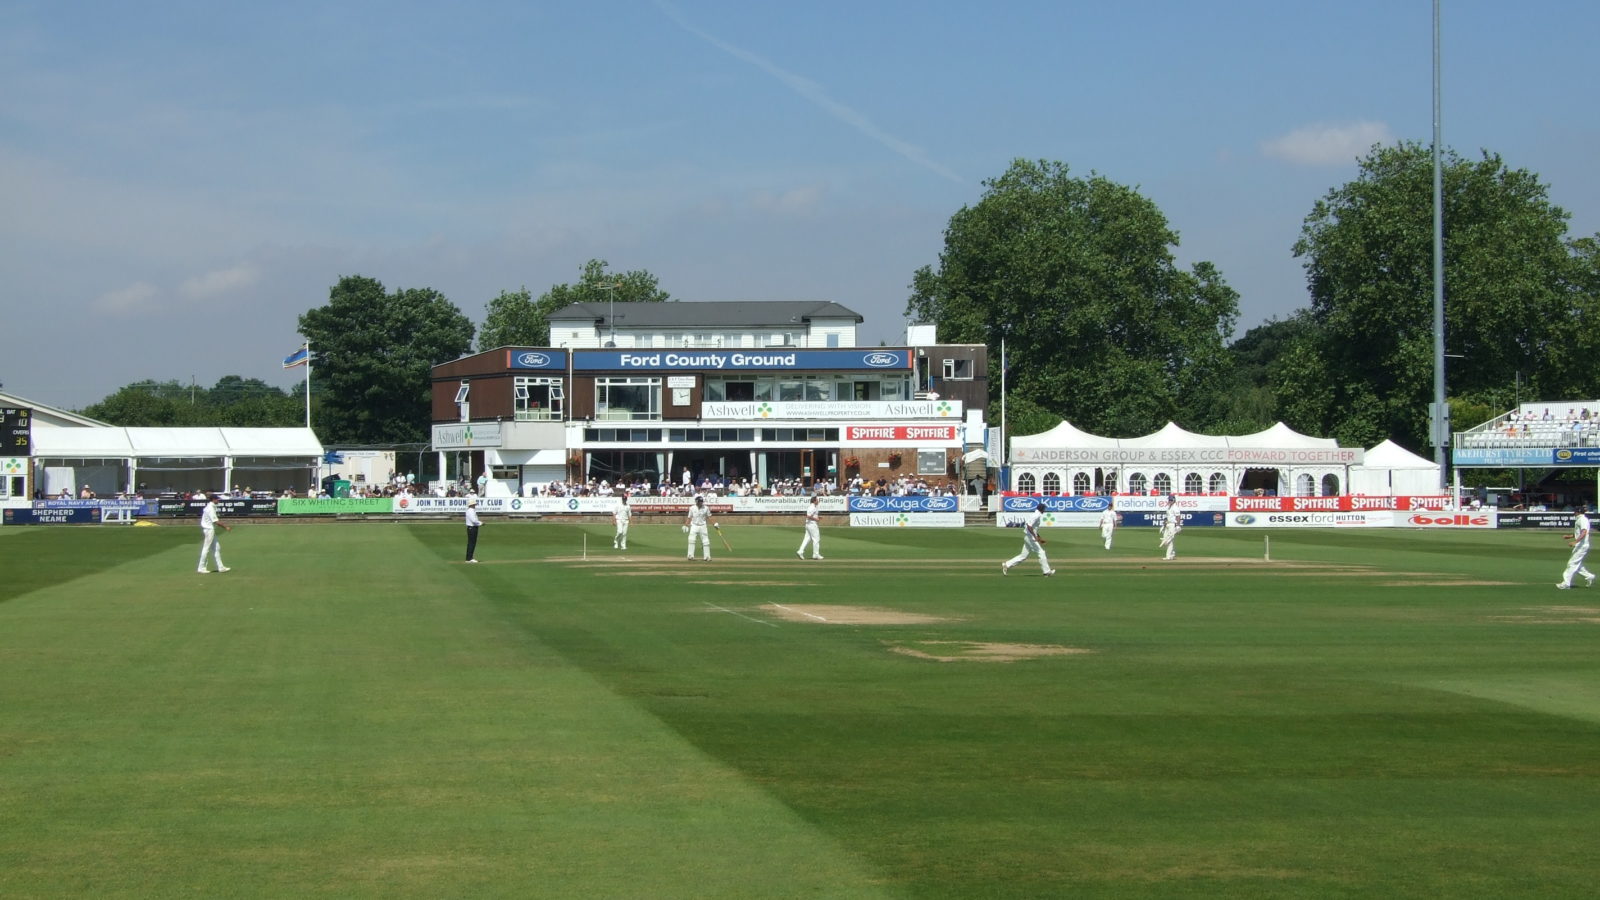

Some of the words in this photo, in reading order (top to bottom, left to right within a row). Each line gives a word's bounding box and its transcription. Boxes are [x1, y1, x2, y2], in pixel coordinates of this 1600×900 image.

[525, 354, 543, 364] Ford
[621, 355, 660, 366] Ford
[665, 354, 726, 368] County
[731, 354, 795, 366] Ground
[870, 354, 893, 364] Ford
[707, 404, 755, 416] Ashwell
[886, 404, 933, 415] Ashwell
[438, 429, 464, 445] Ashwell
[852, 428, 895, 438] SPITFIRE
[906, 428, 950, 438] SPITFIRE
[1032, 451, 1098, 460] ANDERSON
[1103, 451, 1144, 460] GROUP
[1149, 451, 1159, 460] &
[1162, 451, 1195, 460] ESSEX
[1200, 451, 1224, 460] CCC
[1228, 451, 1286, 460] FORWARD
[1292, 451, 1354, 460] TOGETHER
[856, 499, 879, 508] Ford
[886, 499, 919, 509] Kuga
[926, 499, 949, 508] Ford
[1010, 499, 1034, 508] Ford
[1041, 499, 1073, 510] Kuga
[1080, 499, 1104, 508] Ford
[1117, 498, 1156, 508] national
[1236, 498, 1281, 509] SPITFIRE
[1294, 498, 1339, 509] SPITFIRE
[1352, 498, 1397, 509] SPITFIRE
[854, 515, 895, 525] Ashwell
